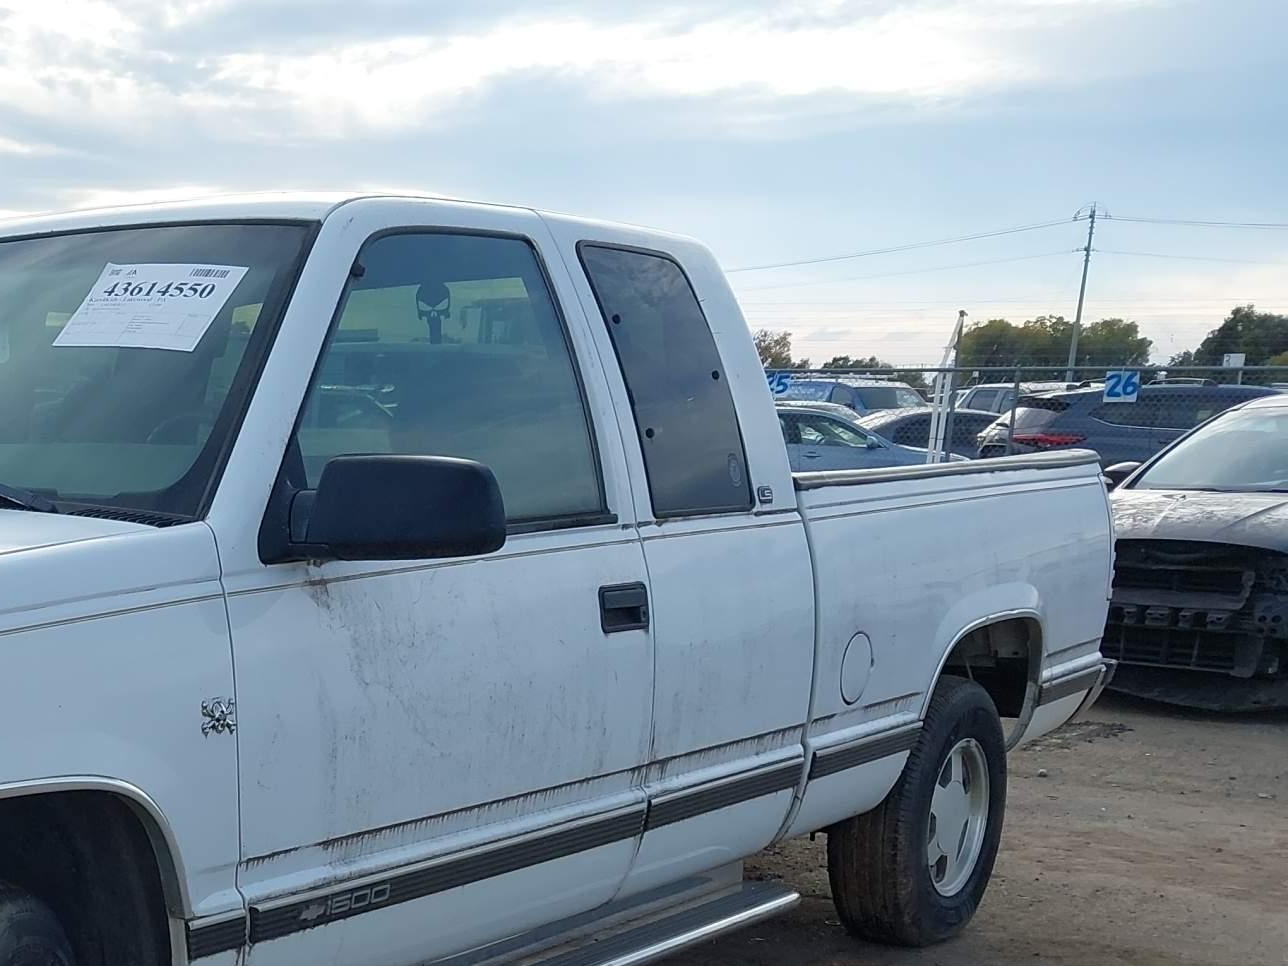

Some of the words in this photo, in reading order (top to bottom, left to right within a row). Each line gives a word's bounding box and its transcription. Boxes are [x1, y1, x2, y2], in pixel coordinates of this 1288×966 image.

[103, 281, 216, 299] 43614550
[1106, 372, 1138, 397] 26
[326, 884, 391, 916] 1500
